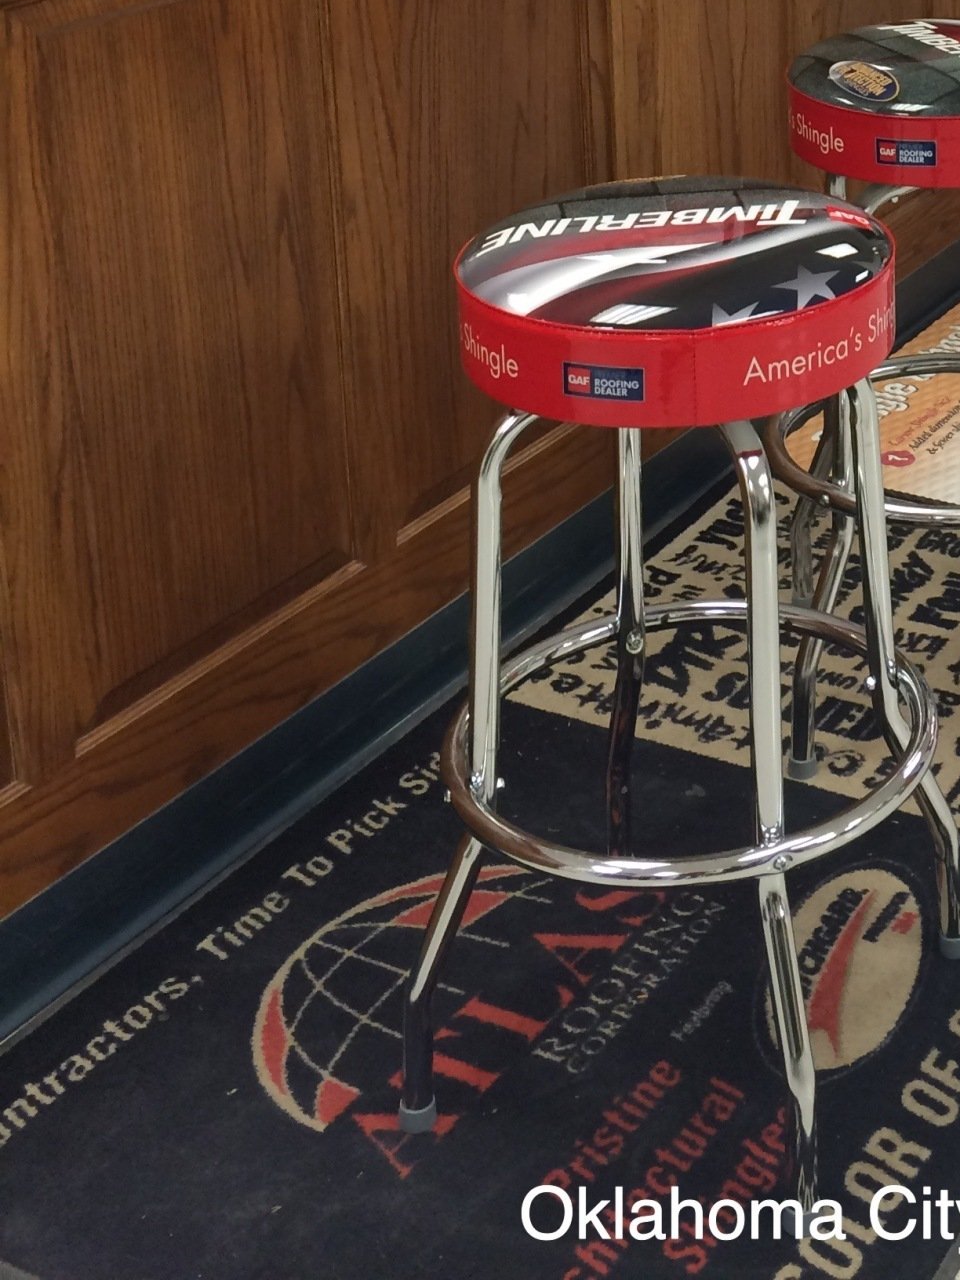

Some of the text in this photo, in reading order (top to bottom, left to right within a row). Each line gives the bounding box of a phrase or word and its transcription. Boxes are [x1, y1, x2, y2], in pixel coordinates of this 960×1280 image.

[796, 113, 845, 154] Shingle
[880, 147, 896, 156] GAF
[899, 149, 934, 158] ROOFING
[463, 327, 519, 379] Shingle
[743, 327, 862, 387] America's
[568, 374, 590, 385] GAF
[594, 378, 640, 389] ROOFING
[594, 386, 628, 397] DEALER
[197, 889, 292, 964] Time
[283, 854, 335, 889] To
[325, 797, 407, 856] Pick
[532, 892, 706, 1064] ROOFING
[566, 899, 727, 1076] CORPORATION
